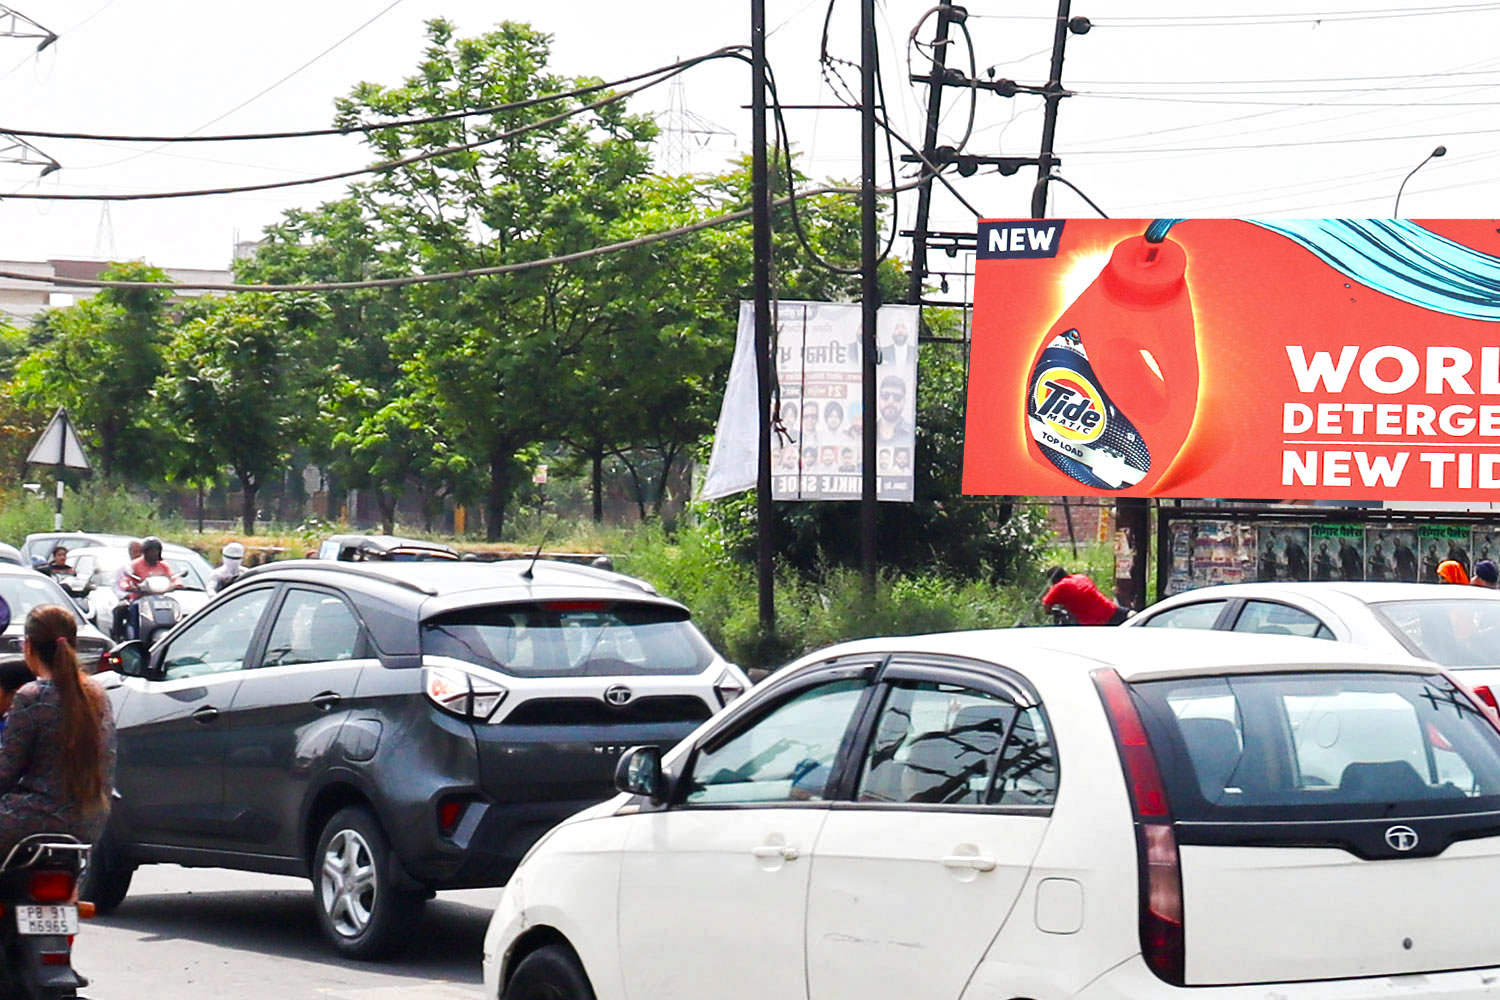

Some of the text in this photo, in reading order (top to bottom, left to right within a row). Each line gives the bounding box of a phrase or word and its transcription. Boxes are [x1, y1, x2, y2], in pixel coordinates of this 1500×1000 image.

[988, 226, 1056, 252] NEW
[1037, 381, 1101, 429] Tide
[1047, 413, 1091, 434] MATIC
[1042, 431, 1084, 458] TOP LOAD
[1282, 450, 1410, 488] NEW
